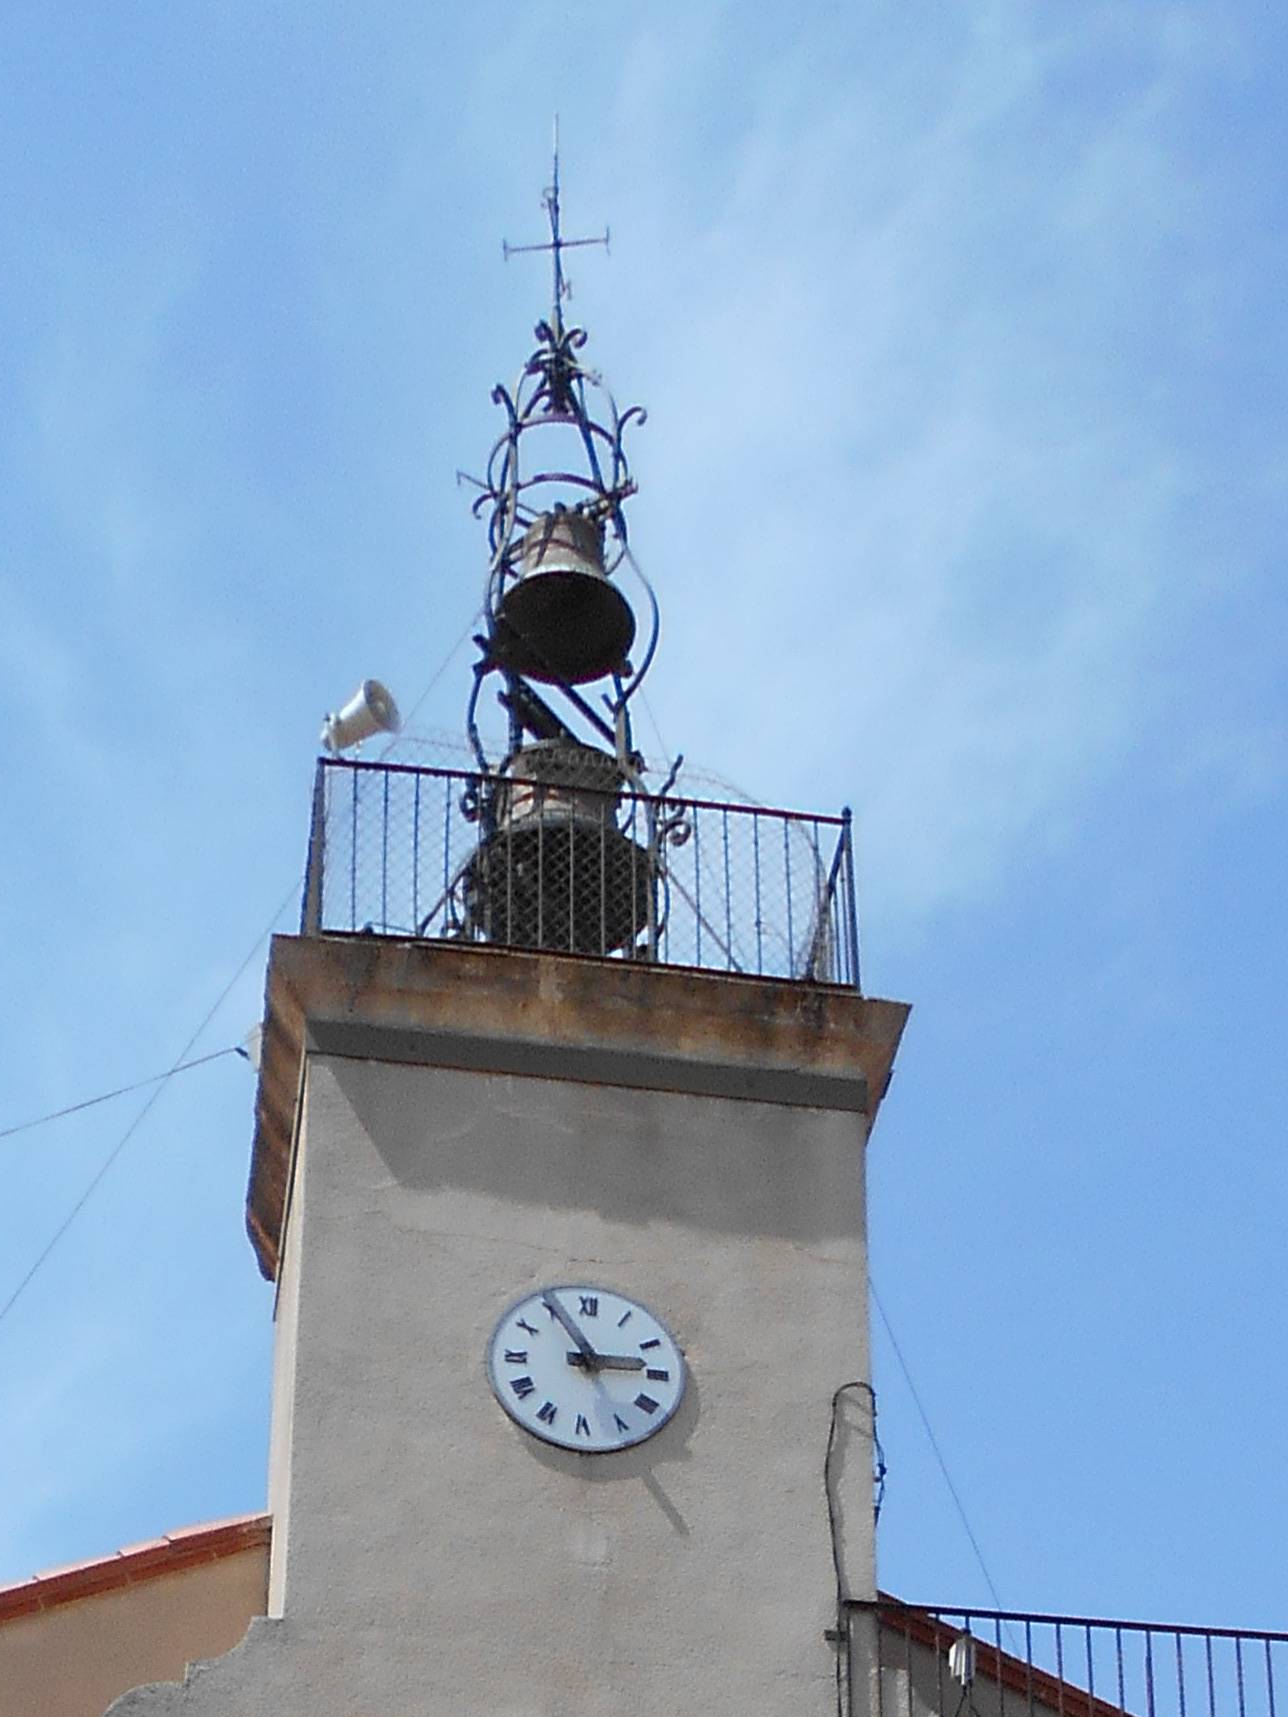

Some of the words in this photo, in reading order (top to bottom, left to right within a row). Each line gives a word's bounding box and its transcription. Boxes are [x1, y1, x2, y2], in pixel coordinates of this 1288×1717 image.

[579, 1296, 598, 1317] XII
[516, 1318, 539, 1336] X
[618, 1311, 631, 1327] I
[504, 1349, 527, 1364] IX
[510, 1376, 535, 1400] VIII
[536, 1401, 557, 1425] VII
[614, 1413, 629, 1433] V
[575, 1414, 590, 1436] VI
